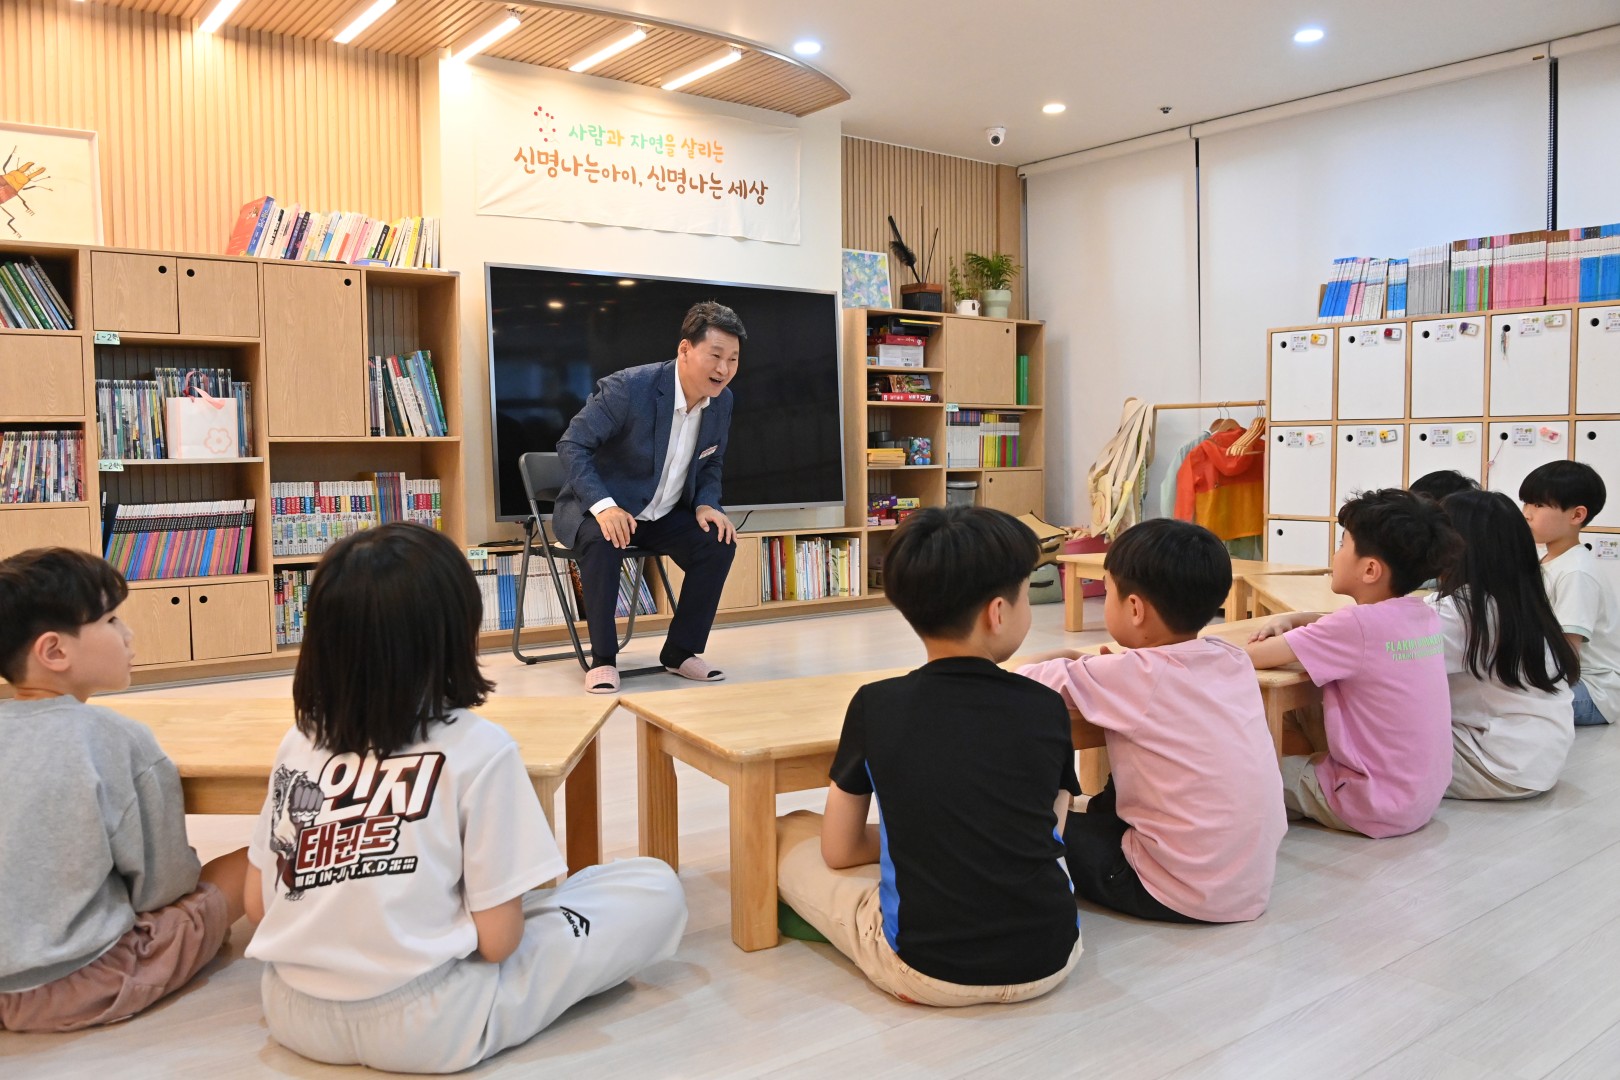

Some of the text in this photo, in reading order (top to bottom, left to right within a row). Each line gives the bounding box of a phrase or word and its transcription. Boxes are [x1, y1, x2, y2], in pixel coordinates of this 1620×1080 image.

[569, 123, 724, 164] 사람과 자연을 살리는
[514, 146, 768, 205] 신명나는아이, 신명나는 세상
[314, 752, 445, 826] 인지
[296, 815, 400, 873] 태권도
[350, 860, 387, 876] T.K.D
